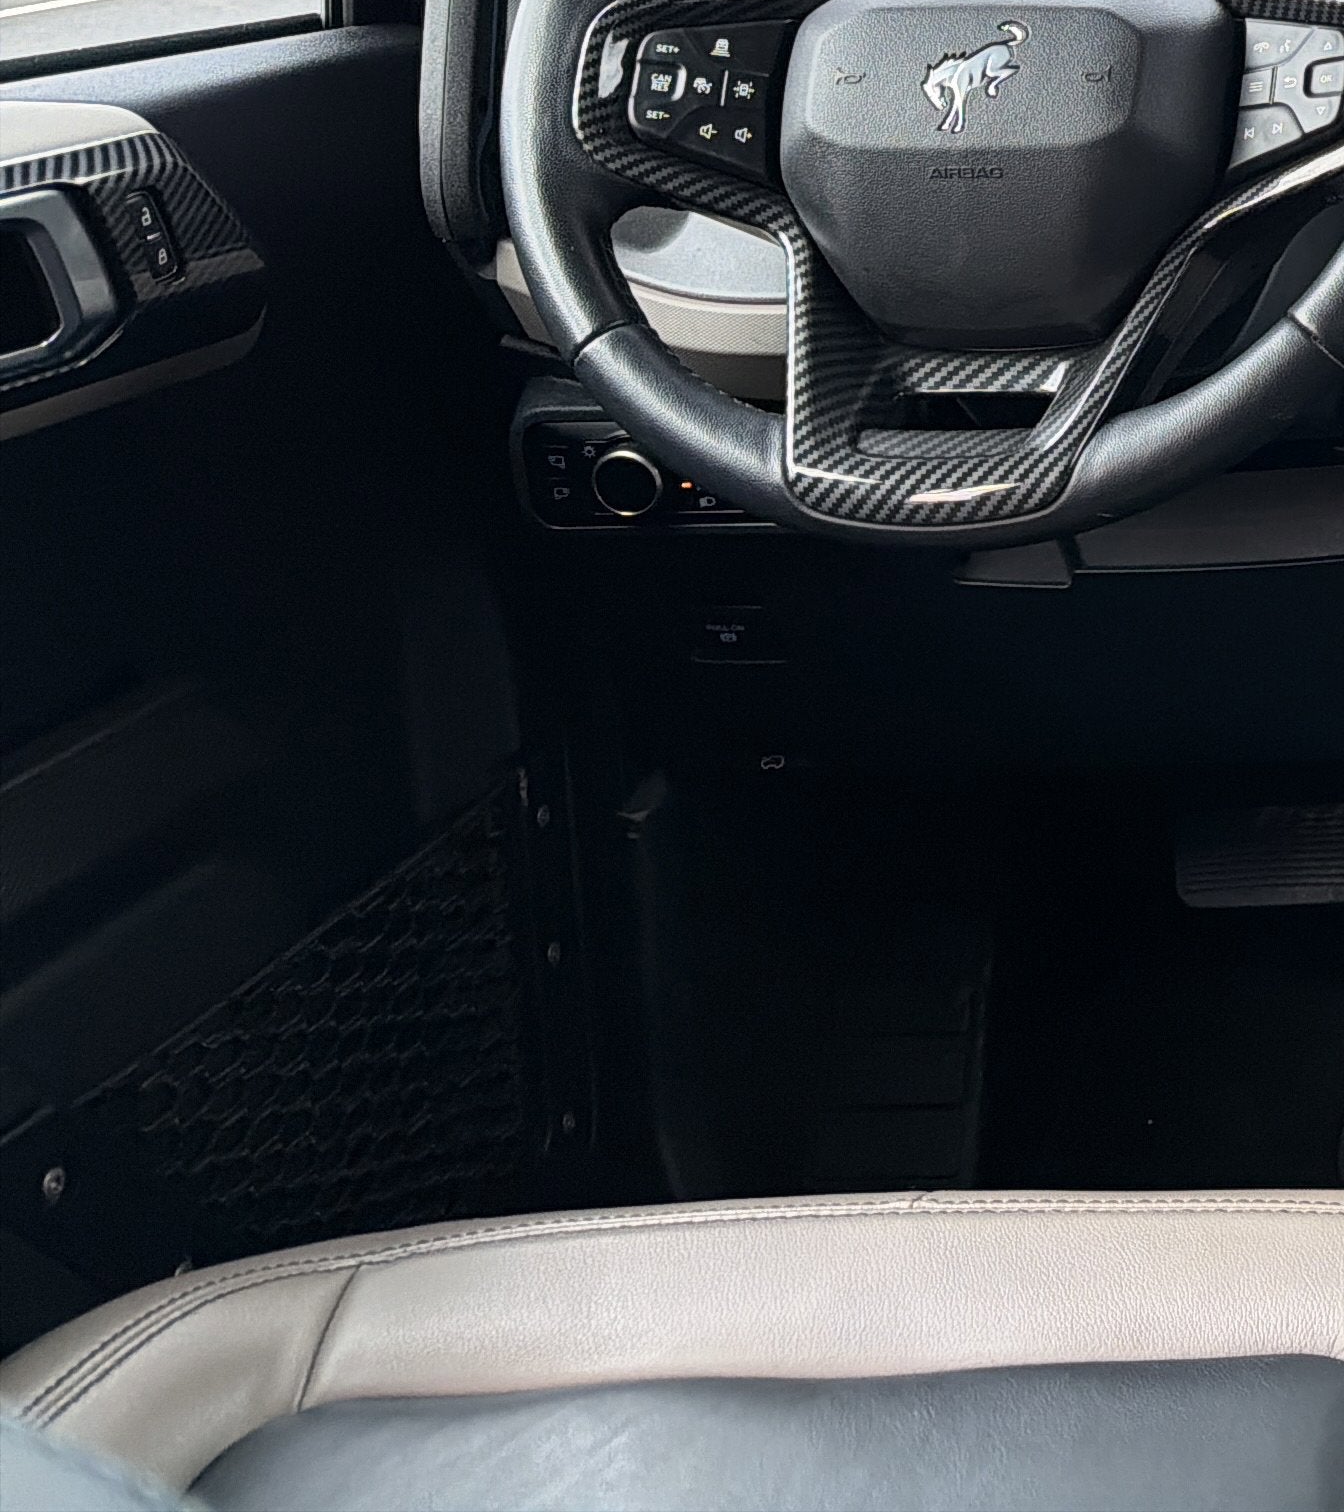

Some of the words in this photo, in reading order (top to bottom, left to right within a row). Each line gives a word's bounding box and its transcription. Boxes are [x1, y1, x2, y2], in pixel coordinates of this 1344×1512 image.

[656, 44, 680, 54] SET+
[651, 73, 672, 82] CAN
[651, 83, 669, 92] RES
[929, 167, 1004, 179] AIRBAG
